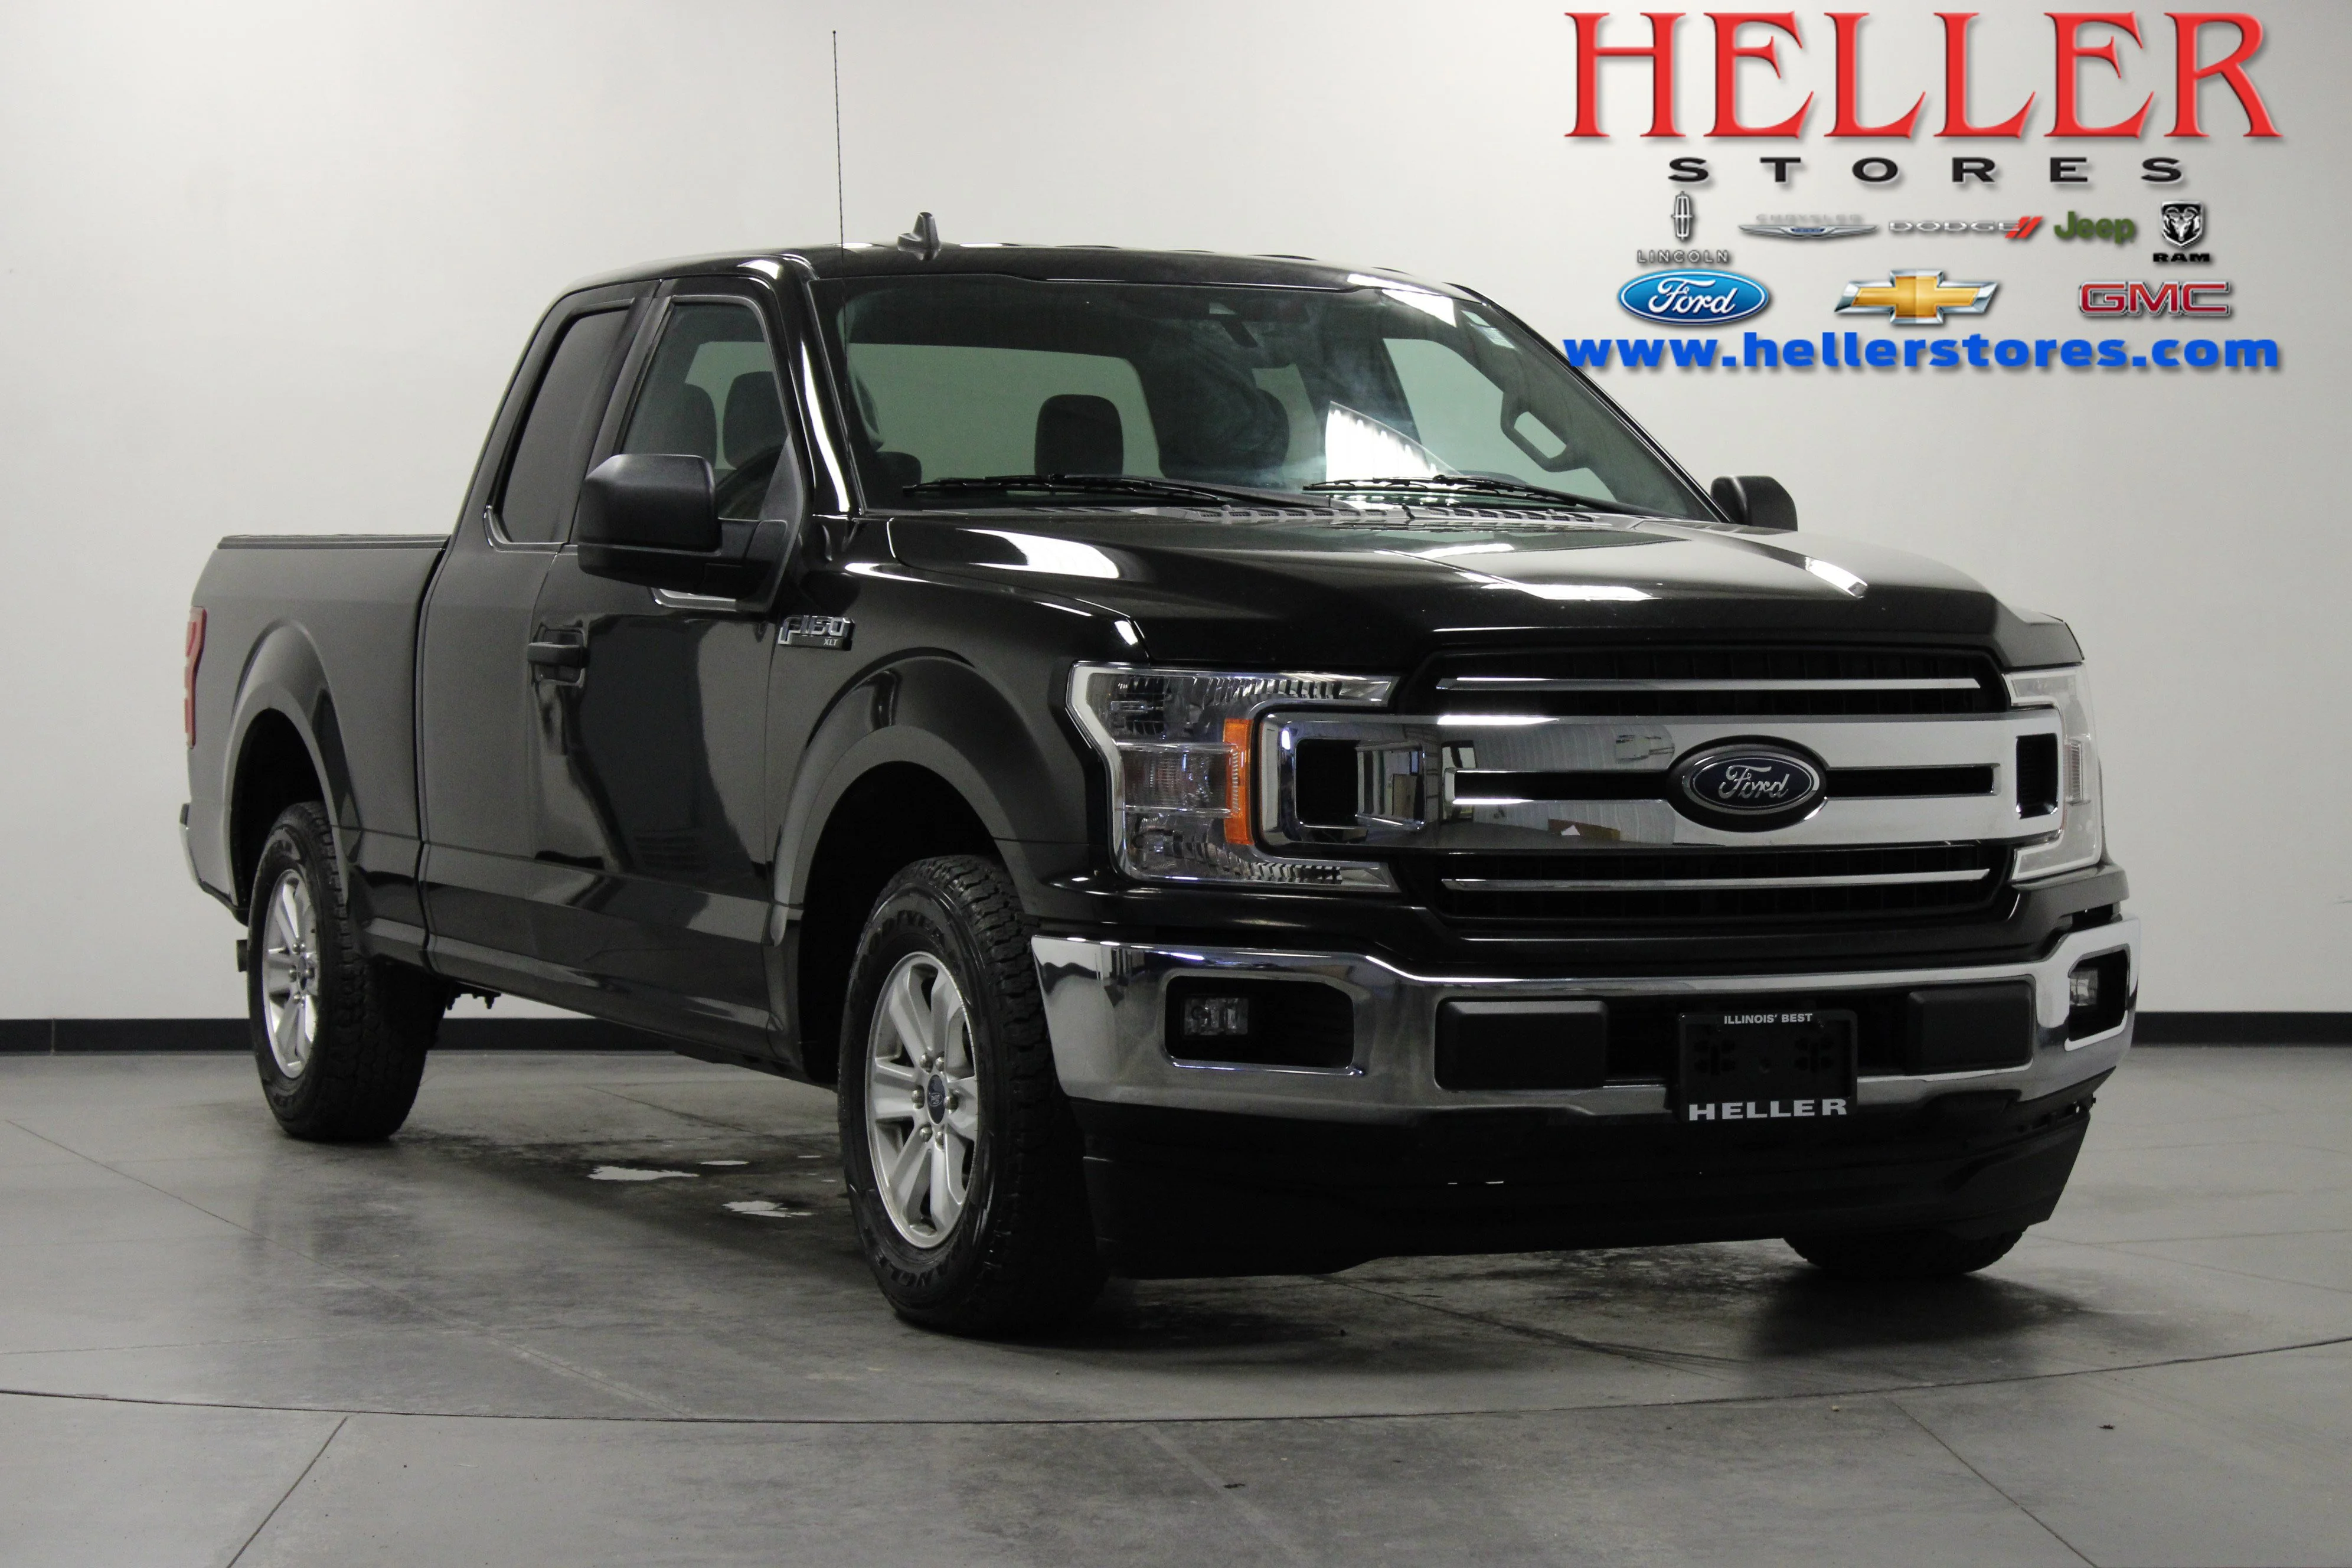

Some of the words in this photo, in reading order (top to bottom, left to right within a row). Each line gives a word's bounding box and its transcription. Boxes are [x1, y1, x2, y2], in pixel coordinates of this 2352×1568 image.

[1718, 765, 1790, 799] Ford
[1781, 1013, 1812, 1023] BEST
[1688, 1099, 1847, 1121] HELLER
